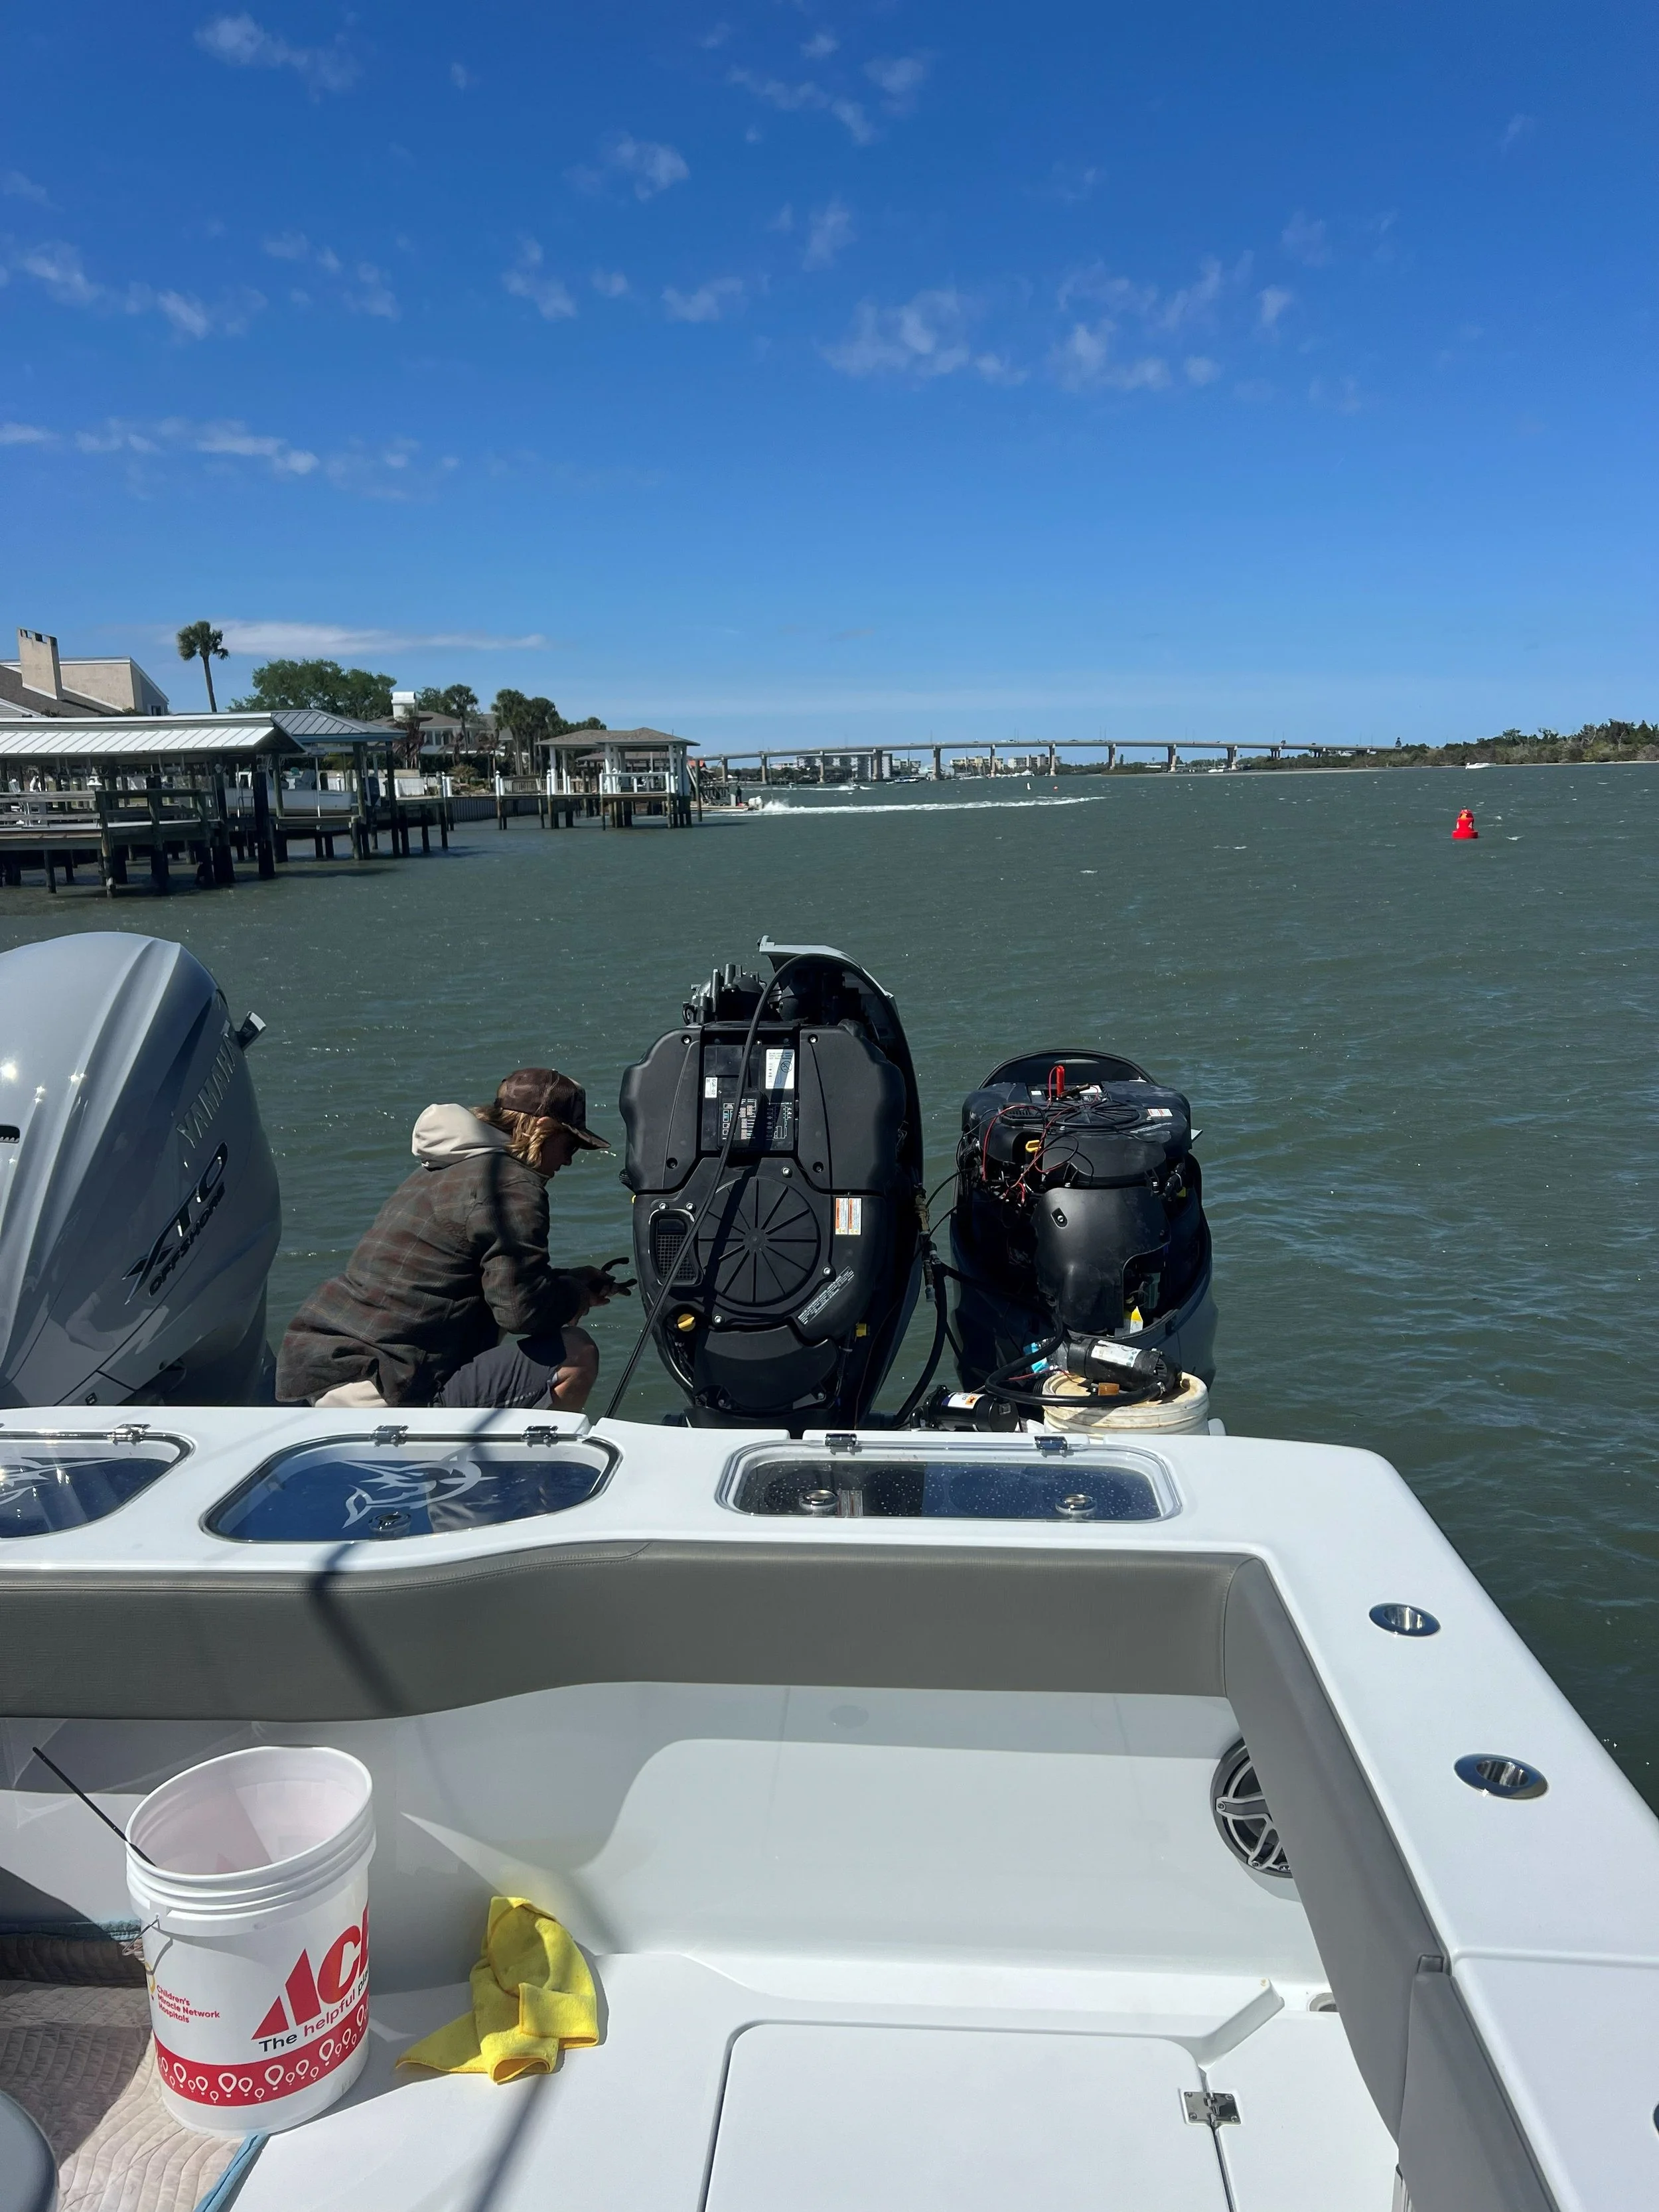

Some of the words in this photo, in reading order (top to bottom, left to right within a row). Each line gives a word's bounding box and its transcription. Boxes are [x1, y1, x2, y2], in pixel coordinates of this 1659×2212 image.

[177, 1033, 235, 1148] YAMAHA
[122, 1142, 228, 1305] XTO
[148, 1182, 226, 1297] OFFSHORE
[157, 1984, 190, 2006] Children's
[157, 1993, 181, 2012] Miracle
[182, 2006, 220, 2018] Network
[159, 2002, 190, 2024] Hospitals
[258, 2033, 298, 2052] The
[304, 1988, 356, 2037] helpful
